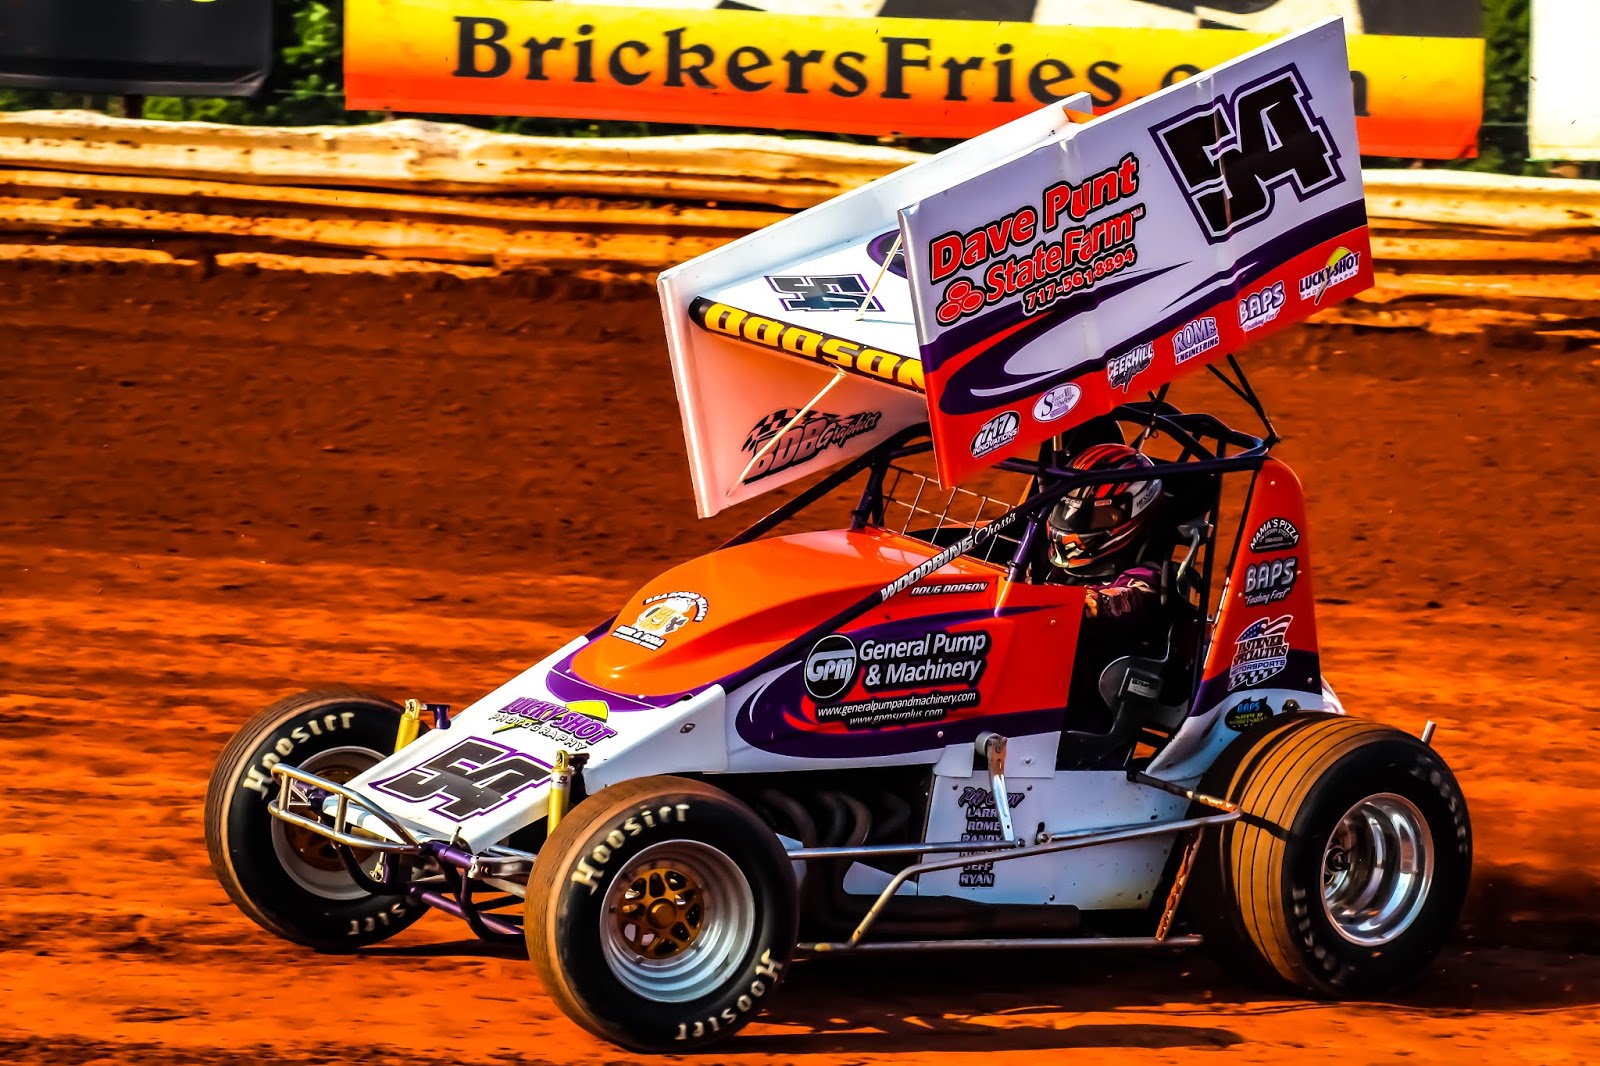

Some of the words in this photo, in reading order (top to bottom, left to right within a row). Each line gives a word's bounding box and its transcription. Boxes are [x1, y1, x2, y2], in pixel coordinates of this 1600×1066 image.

[452, 15, 1372, 118] BrickersFries
[1148, 62, 1347, 245] 54
[930, 205, 1039, 285] Dave
[1044, 153, 1139, 230] Punt
[1025, 247, 1135, 310] 717-5618894
[1299, 265, 1332, 293] LUCKY
[1333, 252, 1360, 277] SHOT
[1238, 281, 1285, 326] BAPS
[1173, 317, 1217, 354] ROME
[1176, 336, 1219, 364] ENGINEERING
[816, 412, 881, 448] Graphics
[1250, 519, 1279, 549] MAMA'S
[1279, 519, 1299, 544] PIZZA
[880, 535, 973, 602] WOODRING
[974, 512, 1017, 546] Chassis
[1245, 558, 1296, 592] BAPS
[911, 586, 942, 596] DOUG
[943, 583, 989, 594] DODSON
[859, 633, 930, 661] General
[934, 634, 986, 655] Pump
[865, 665, 881, 686] &
[885, 658, 982, 684] Machinery
[489, 713, 588, 751] PHOTOGRAPHY
[550, 711, 619, 745] SHOT
[368, 735, 553, 822] 54
[966, 807, 999, 818] LARR
[960, 873, 994, 885] RYAN
